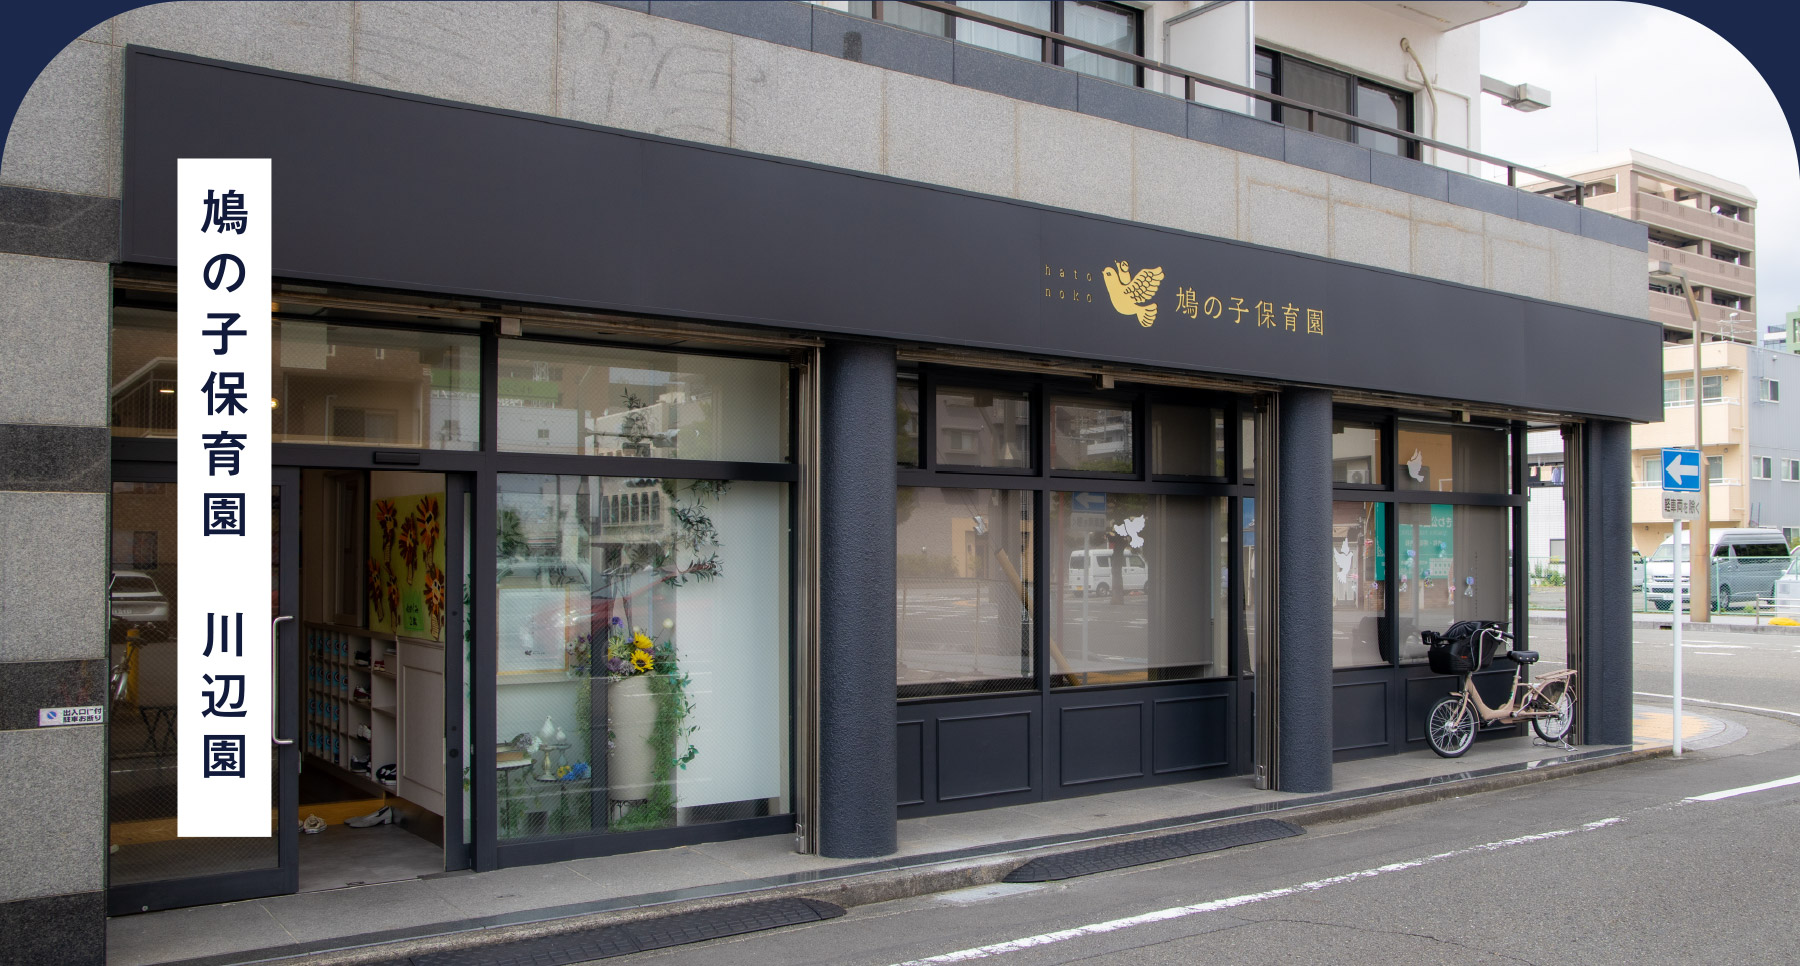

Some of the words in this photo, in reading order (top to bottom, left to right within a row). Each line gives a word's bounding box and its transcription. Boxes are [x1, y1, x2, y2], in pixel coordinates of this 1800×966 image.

[1045, 264, 1092, 282] hato
[1045, 288, 1092, 303] noko
[1175, 286, 1324, 336] 鳩の子保育園
[1664, 498, 1700, 514] 軽車両を除く
[63, 707, 102, 717] 出入口に付
[63, 715, 102, 723] 駐車お断り
